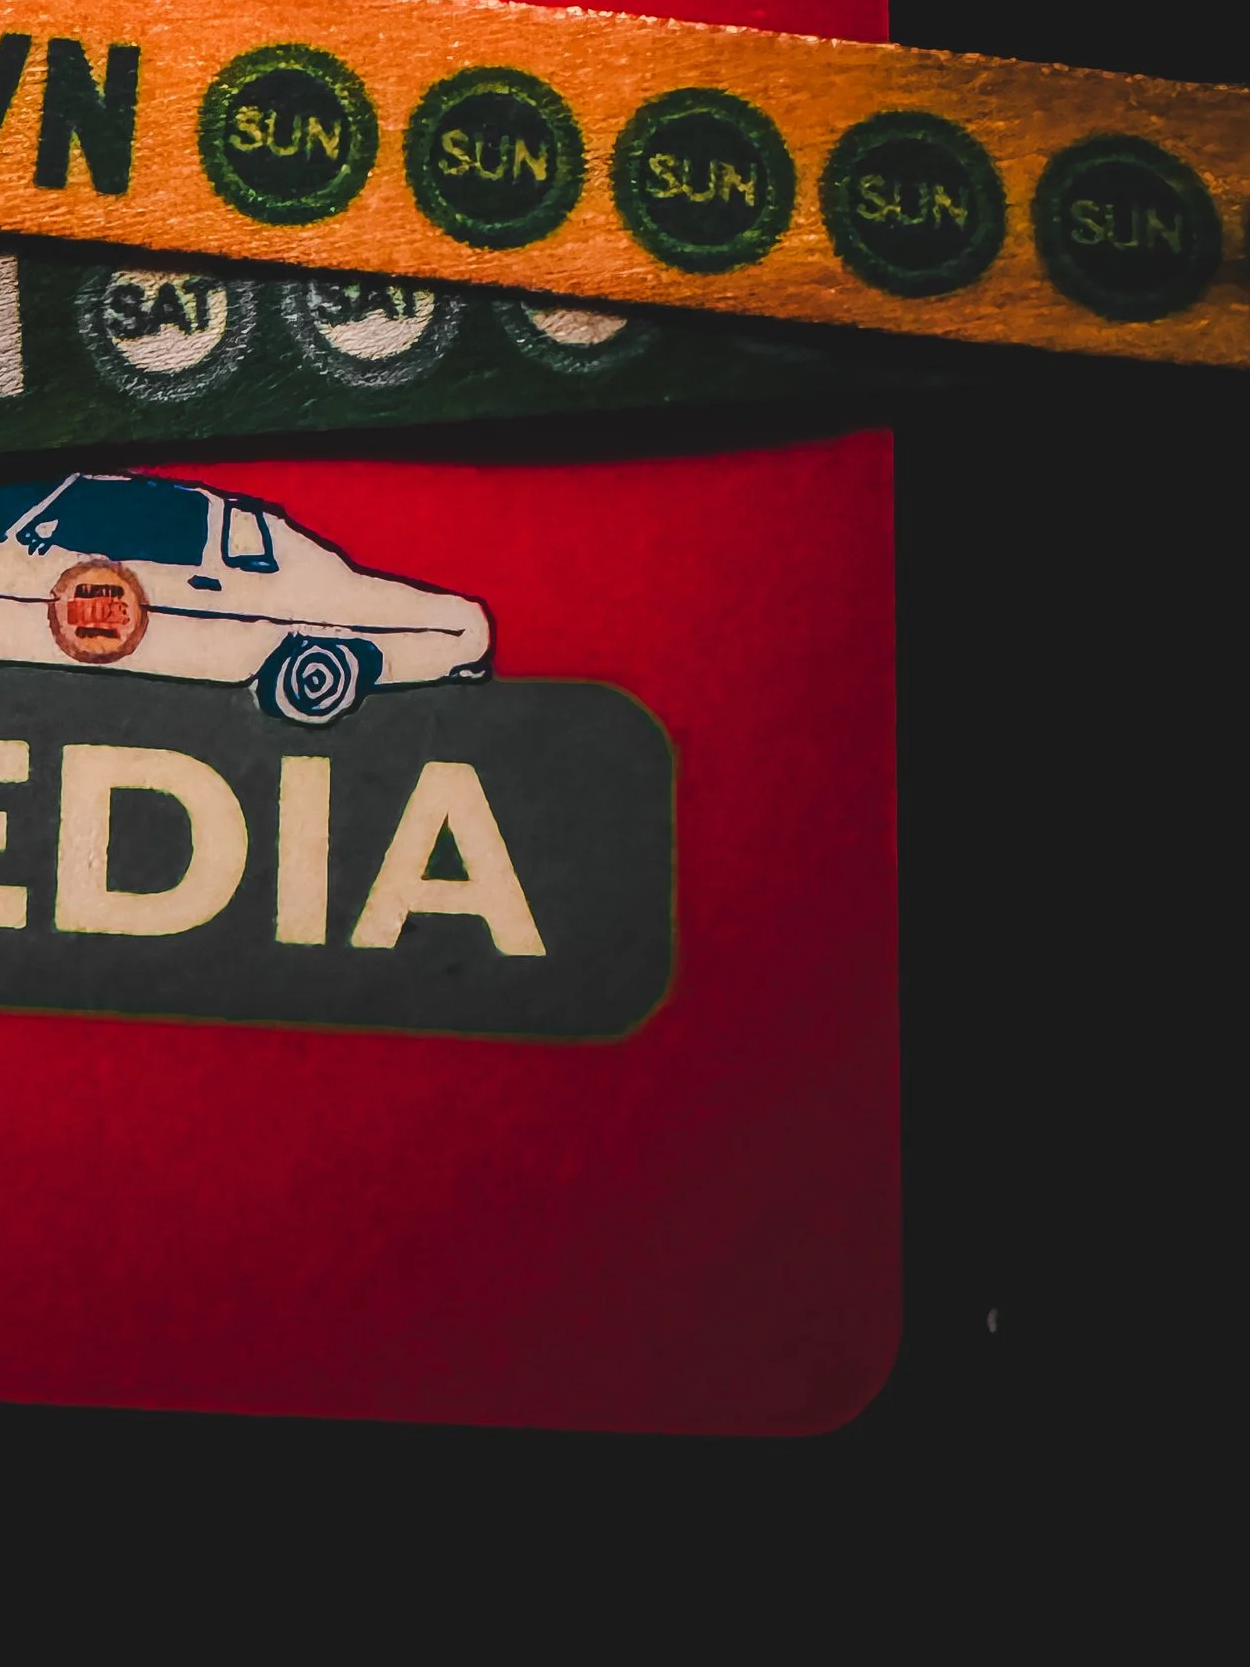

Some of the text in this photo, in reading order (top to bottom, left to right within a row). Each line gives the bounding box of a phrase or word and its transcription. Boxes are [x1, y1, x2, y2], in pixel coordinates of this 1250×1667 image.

[229, 104, 343, 160] SUN
[438, 129, 548, 182] SUN
[647, 152, 757, 208] SUN
[856, 172, 969, 230] SUN
[1070, 199, 1184, 254] SUN
[103, 278, 217, 339] SAT
